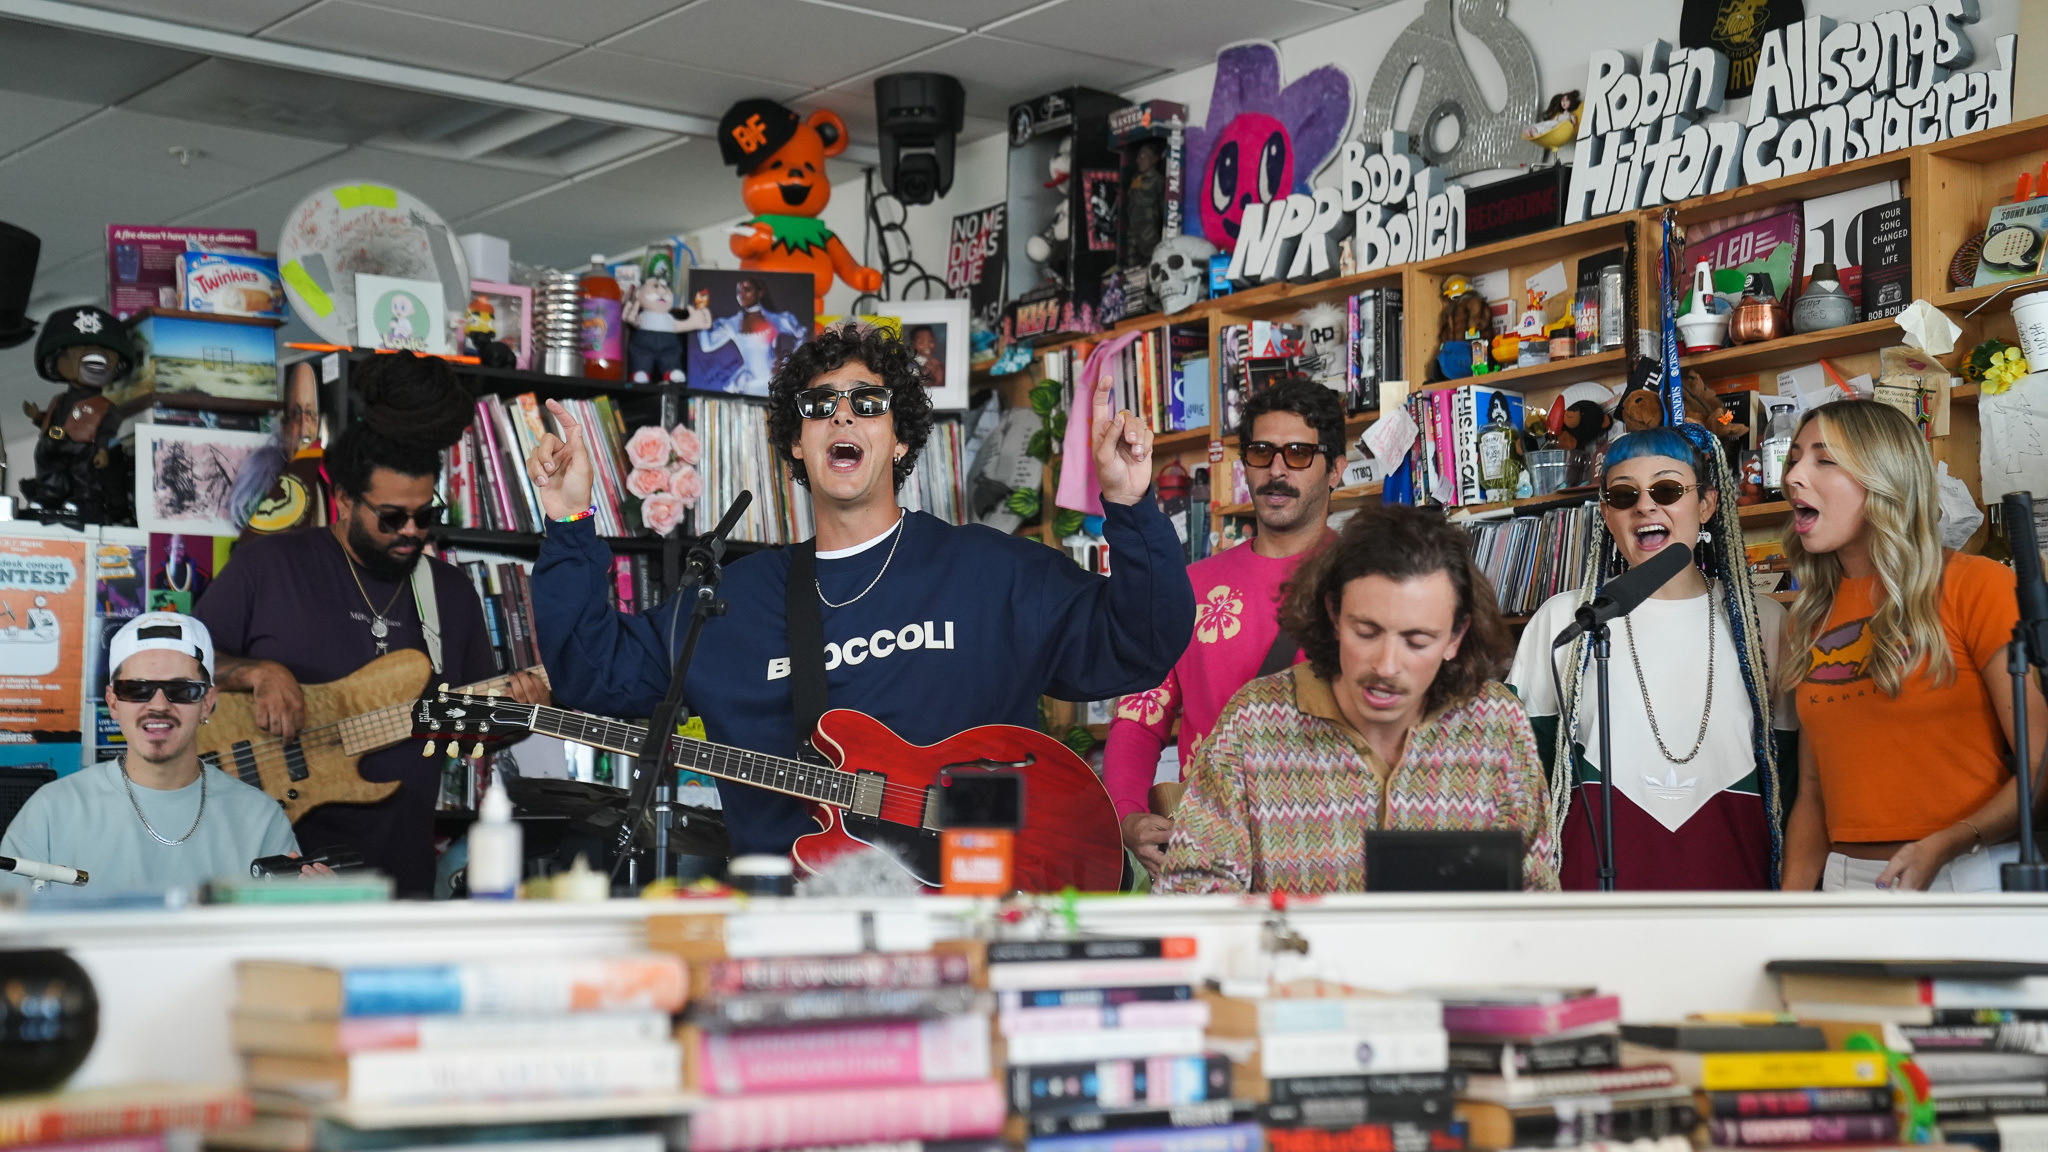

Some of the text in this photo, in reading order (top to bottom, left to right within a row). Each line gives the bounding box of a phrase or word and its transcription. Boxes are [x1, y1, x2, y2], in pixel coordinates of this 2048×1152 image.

[1578, 41, 1714, 139] Robin
[1342, 130, 1412, 211] Bob
[1565, 116, 1743, 224] Hilton
[953, 205, 1005, 242] NO ME
[1356, 168, 1466, 275] Boilen
[1467, 187, 1557, 233] RECORDING
[1880, 208, 1901, 220] YOUR
[2000, 208, 2025, 221] SOUND
[137, 231, 165, 240] doesn't
[166, 232, 188, 241] have
[1226, 188, 1343, 282] NPR
[1872, 229, 1908, 245] CHANGED
[1880, 220, 1901, 232] SONG
[951, 232, 998, 266] DIGAS
[1715, 231, 1754, 271] LED
[1882, 254, 1898, 265] LIFE
[1884, 243, 1896, 253] MY
[194, 267, 259, 294] Twinkies
[948, 260, 983, 289] QUE
[1016, 298, 1061, 338] KISS
[1575, 307, 1598, 317] BLUE
[1575, 316, 1598, 326] MAN
[1868, 310, 1883, 321] BOB
[1263, 338, 1306, 358] ASK
[1461, 464, 1475, 501] CALL
[26, 562, 64, 570] concert
[767, 620, 955, 681] BOCCOLI
[419, 699, 433, 723] Gibson
